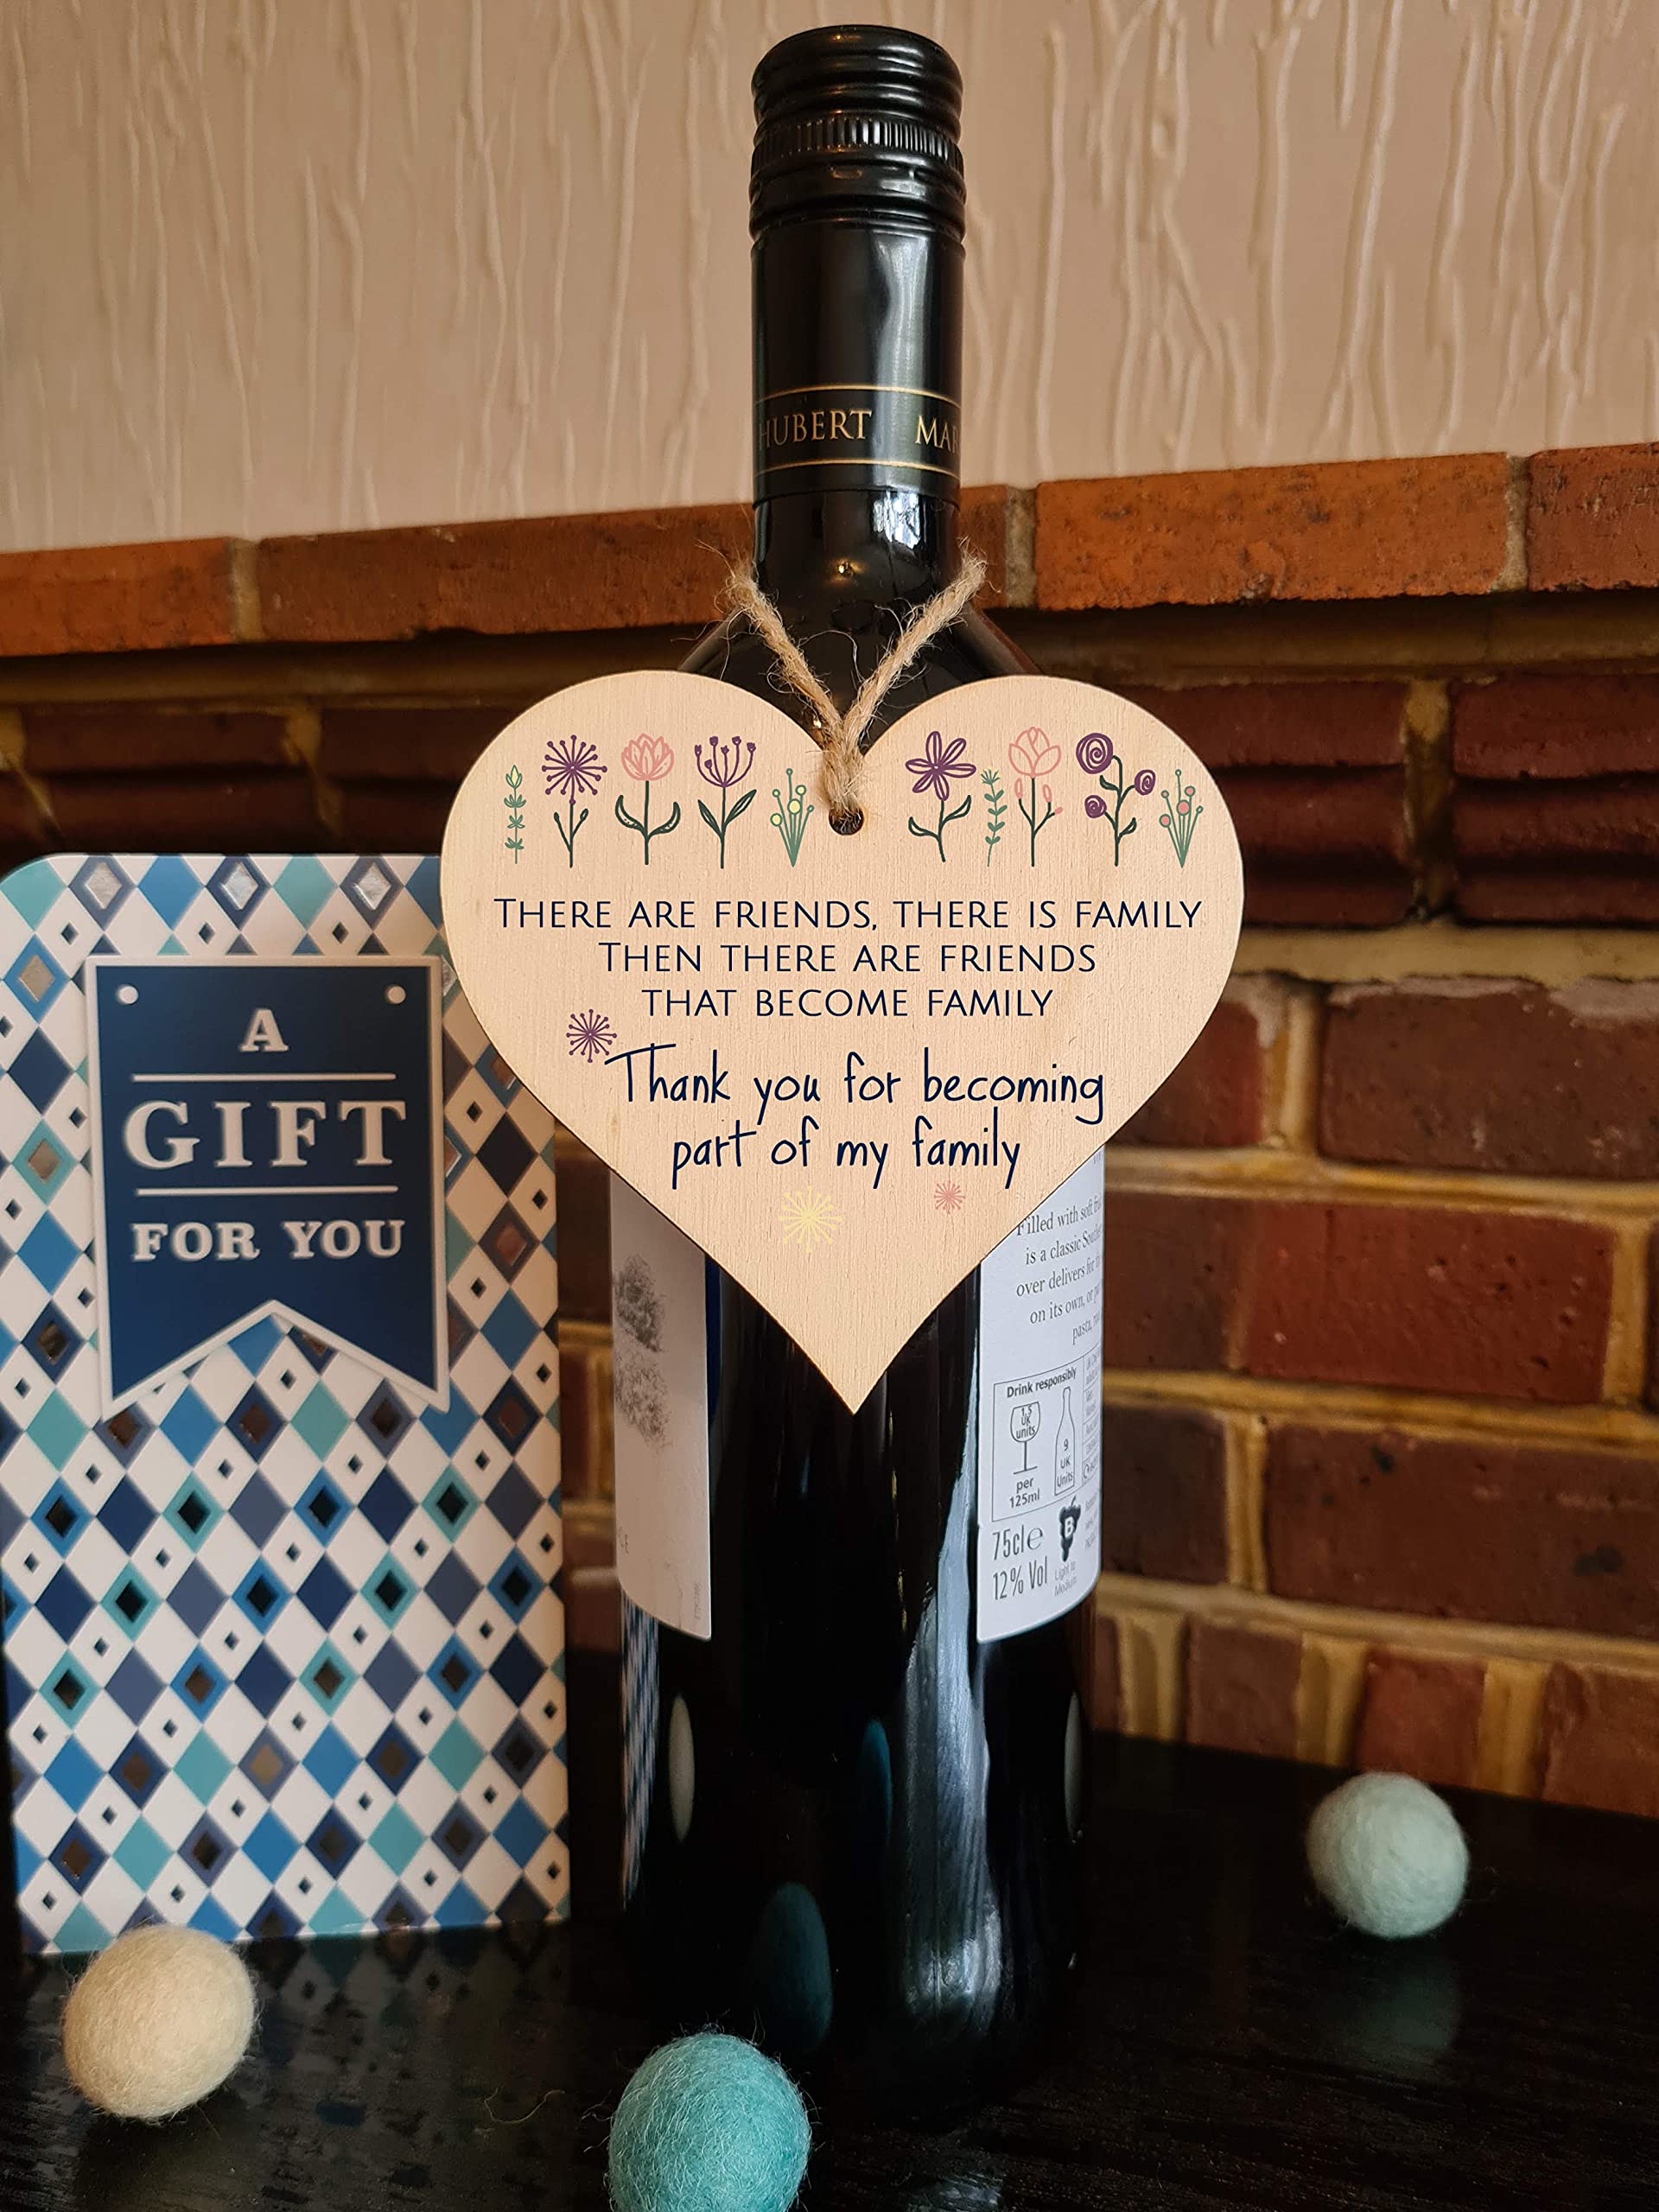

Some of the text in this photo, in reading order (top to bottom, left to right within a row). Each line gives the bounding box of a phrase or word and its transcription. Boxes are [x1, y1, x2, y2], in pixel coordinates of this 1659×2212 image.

[759, 408, 873, 451] HUBERT
[493, 898, 1202, 931] THERE ARE FRIENDS, THERE IS FAMILY
[598, 942, 1096, 973] THEN THERE ARE FRIENDS
[641, 988, 1053, 1017] THAT BECOME FAMILY
[239, 1007, 289, 1052] A
[604, 1043, 1103, 1126] Thank you for becoming
[124, 1099, 407, 1170] GIFT
[672, 1106, 1020, 1190] part of my family
[1057, 1205, 1078, 1227] with
[130, 1219, 405, 1262] FOR YOU
[1026, 1247, 1036, 1265] is
[1039, 1249, 1046, 1262] a
[1050, 1234, 1081, 1260] classic
[1016, 1280, 1045, 1297] over
[1048, 1266, 1084, 1290] delivers
[1030, 1309, 1046, 1325] on
[1049, 1300, 1063, 1319] its
[1065, 1295, 1085, 1314] own,
[1007, 1382, 1033, 1398] Drink
[1035, 1366, 1077, 1390] responsibly
[1015, 1426, 1036, 1440] units
[1020, 1415, 1031, 1427] UK
[1063, 1438, 1069, 1452] 9
[1060, 1455, 1071, 1469] UK
[1016, 1478, 1034, 1494] per
[1057, 1471, 1073, 1487] Units
[1009, 1488, 1039, 1509] 125ml
[1065, 1516, 1074, 1538] B
[992, 1555, 1047, 1600] 12% Vol
